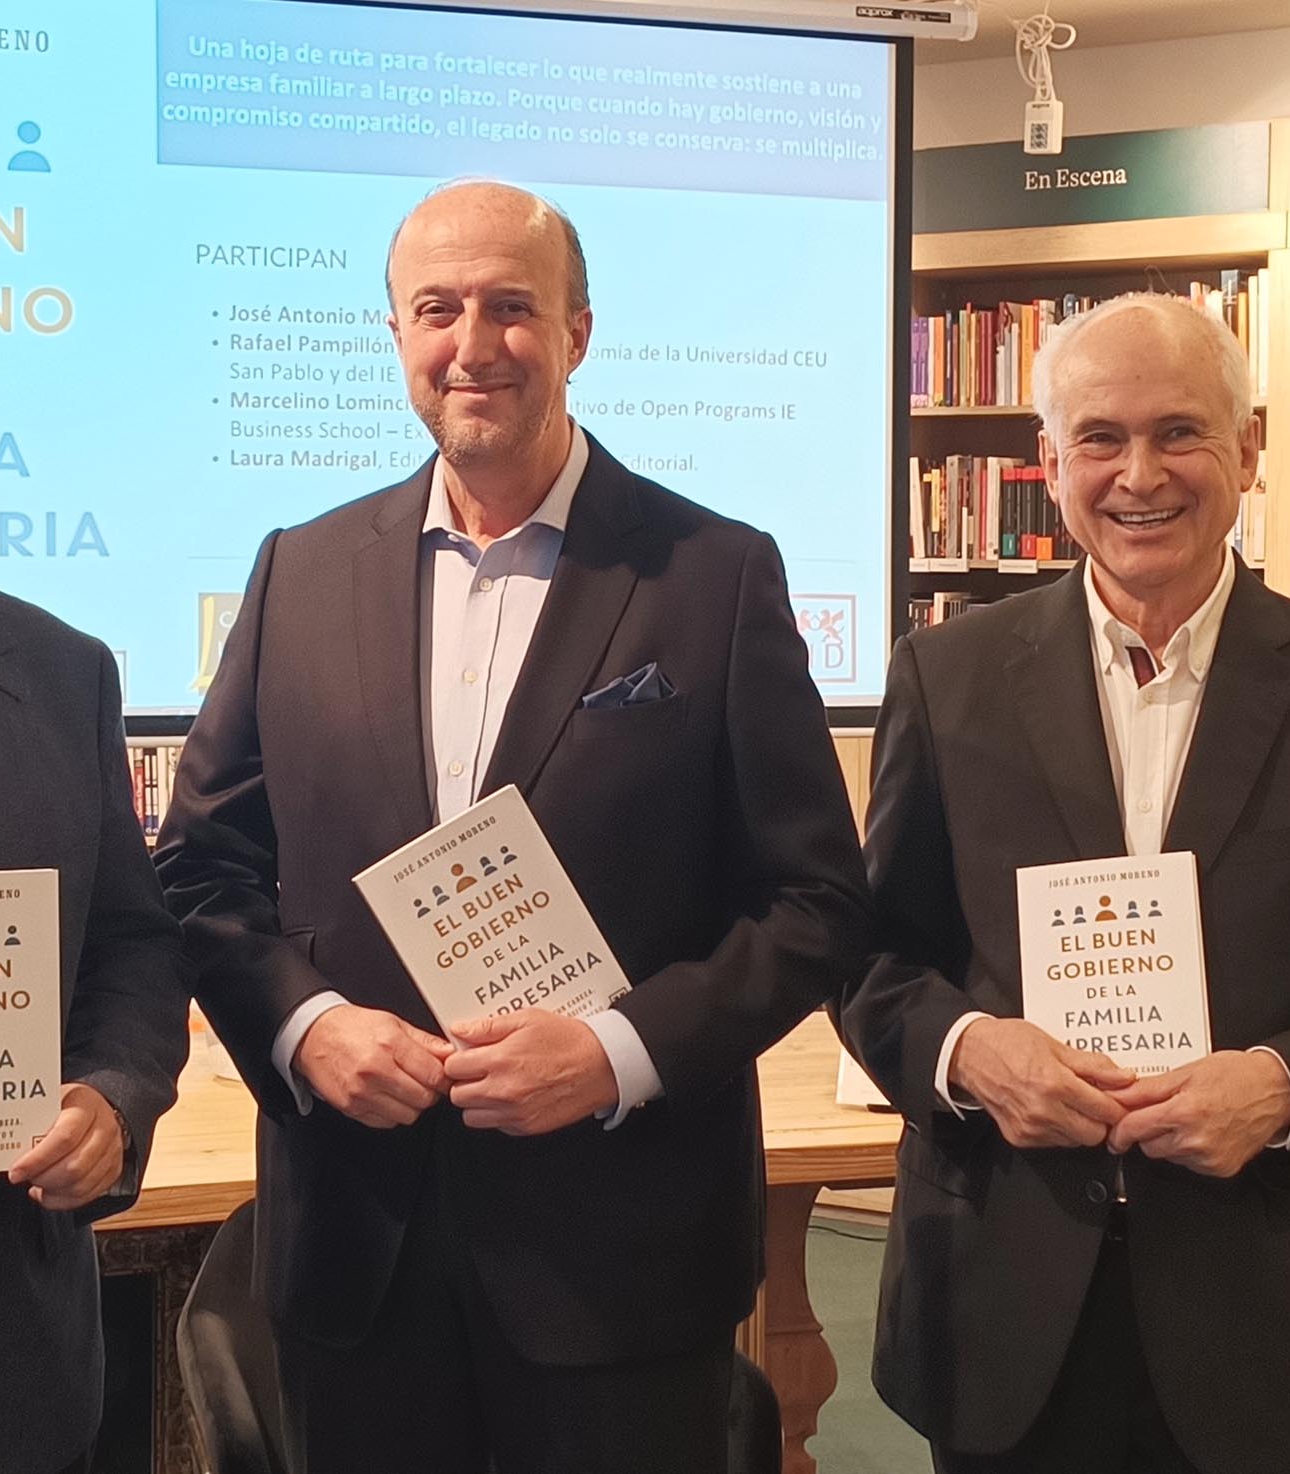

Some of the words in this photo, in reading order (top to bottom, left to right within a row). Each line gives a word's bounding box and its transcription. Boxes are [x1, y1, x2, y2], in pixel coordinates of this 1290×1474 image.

[189, 36, 234, 57] Una
[241, 39, 288, 65] hoja
[295, 43, 323, 63] de
[329, 48, 374, 66] ruta
[381, 53, 428, 72] para
[435, 52, 538, 77] fortalecer
[543, 58, 563, 79] lo
[568, 65, 607, 84] que
[613, 65, 720, 89] realmente
[722, 73, 805, 95] sostiene
[809, 81, 820, 95] a
[826, 81, 862, 98] una
[166, 71, 262, 93] empresa
[269, 74, 355, 98] familiar
[361, 85, 372, 99] a
[379, 80, 433, 106] largo
[439, 84, 502, 107] plazo.
[508, 88, 582, 114] Porque
[588, 96, 662, 116] cuando
[668, 98, 705, 122] hay
[709, 103, 804, 128] gobierno,
[809, 109, 865, 130] visión
[870, 115, 882, 133] y
[162, 104, 303, 128] compromiso
[309, 112, 441, 138] compartido,
[447, 116, 466, 137] el
[471, 117, 542, 142] legado
[547, 125, 574, 142] no
[579, 124, 622, 145] solo
[627, 130, 649, 146] se
[654, 130, 751, 151] conserva:
[755, 139, 776, 154] se
[782, 137, 883, 162] multiplica.
[1024, 170, 1051, 191] En
[1055, 167, 1127, 188] Escena
[196, 244, 347, 269] PARTICIPAN
[229, 305, 271, 322] José
[278, 306, 356, 325] Antonio
[230, 334, 292, 351] Rafael
[299, 336, 394, 357] Pampillón
[639, 344, 660, 361] de
[666, 345, 680, 361] la
[686, 346, 788, 366] Universidad
[793, 351, 827, 368] CEU
[230, 362, 264, 380] San
[271, 363, 324, 382] Pablo
[330, 368, 340, 385] y
[346, 365, 374, 382] del
[380, 366, 397, 382] IE
[230, 392, 329, 410] Marcelino
[614, 400, 635, 416] de
[641, 400, 688, 419] Open
[694, 401, 776, 421] Programs
[781, 404, 796, 420] IE
[230, 421, 312, 438] Business
[318, 422, 380, 439] School
[230, 450, 284, 467] Laura
[290, 451, 382, 471] Madrigal,
[393, 863, 416, 883] JOSÉ
[417, 840, 458, 869] ANTONIO
[458, 815, 497, 843] MORENO
[1049, 876, 1070, 888] JOSÉ
[1073, 873, 1116, 885] ANTONIO
[1120, 870, 1160, 881] MORENO
[433, 914, 462, 938] EL
[462, 873, 525, 919] BUEN
[436, 891, 550, 969] GOBIERNO
[1061, 935, 1085, 953] EL
[1093, 928, 1156, 950] BUEN
[482, 951, 505, 969] DE
[510, 934, 530, 953] LA
[474, 941, 565, 1005] FAMILIA
[1047, 955, 1174, 981] GOBIERNO
[489, 951, 603, 1017] PRESARIA
[1087, 985, 1108, 999] DE
[1116, 984, 1136, 997] LA
[1065, 1005, 1162, 1028] FAMILIA
[1066, 1032, 1193, 1053] PRESARIA
